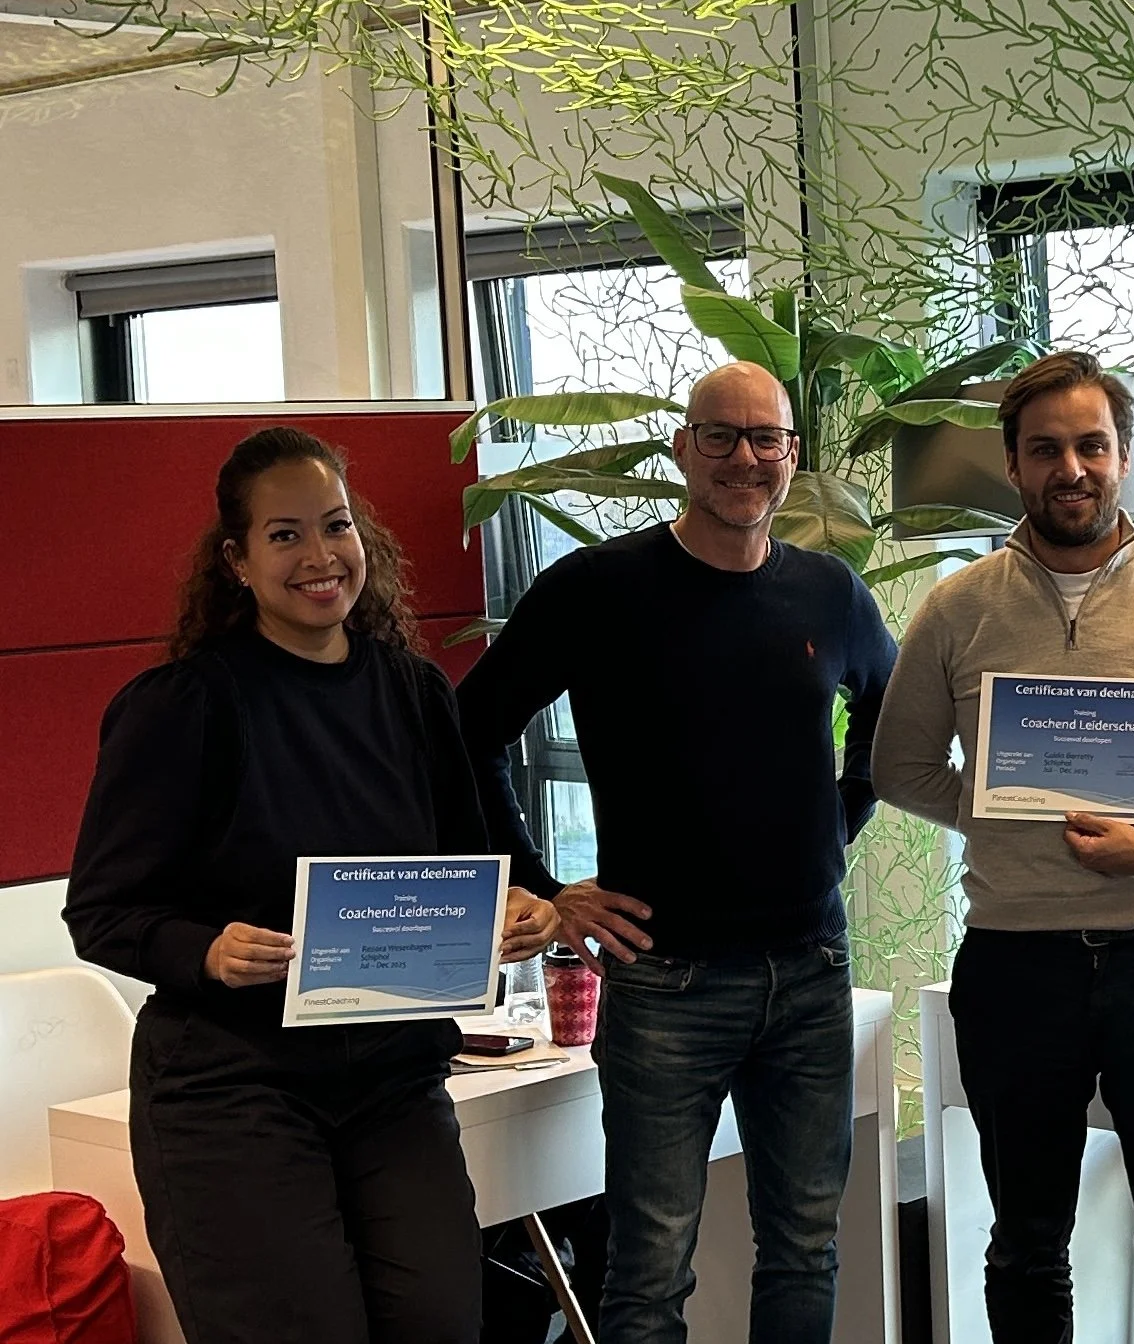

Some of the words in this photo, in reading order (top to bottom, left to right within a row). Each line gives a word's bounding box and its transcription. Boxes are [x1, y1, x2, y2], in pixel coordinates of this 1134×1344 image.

[1015, 684, 1074, 697] Certificaat
[1077, 689, 1097, 697] van
[1021, 718, 1076, 731] Coachend
[333, 868, 395, 881] Certificaat
[398, 870, 418, 879] van
[421, 867, 477, 879] deelname
[339, 906, 396, 920] Coachend
[400, 905, 466, 918] Leiderschap
